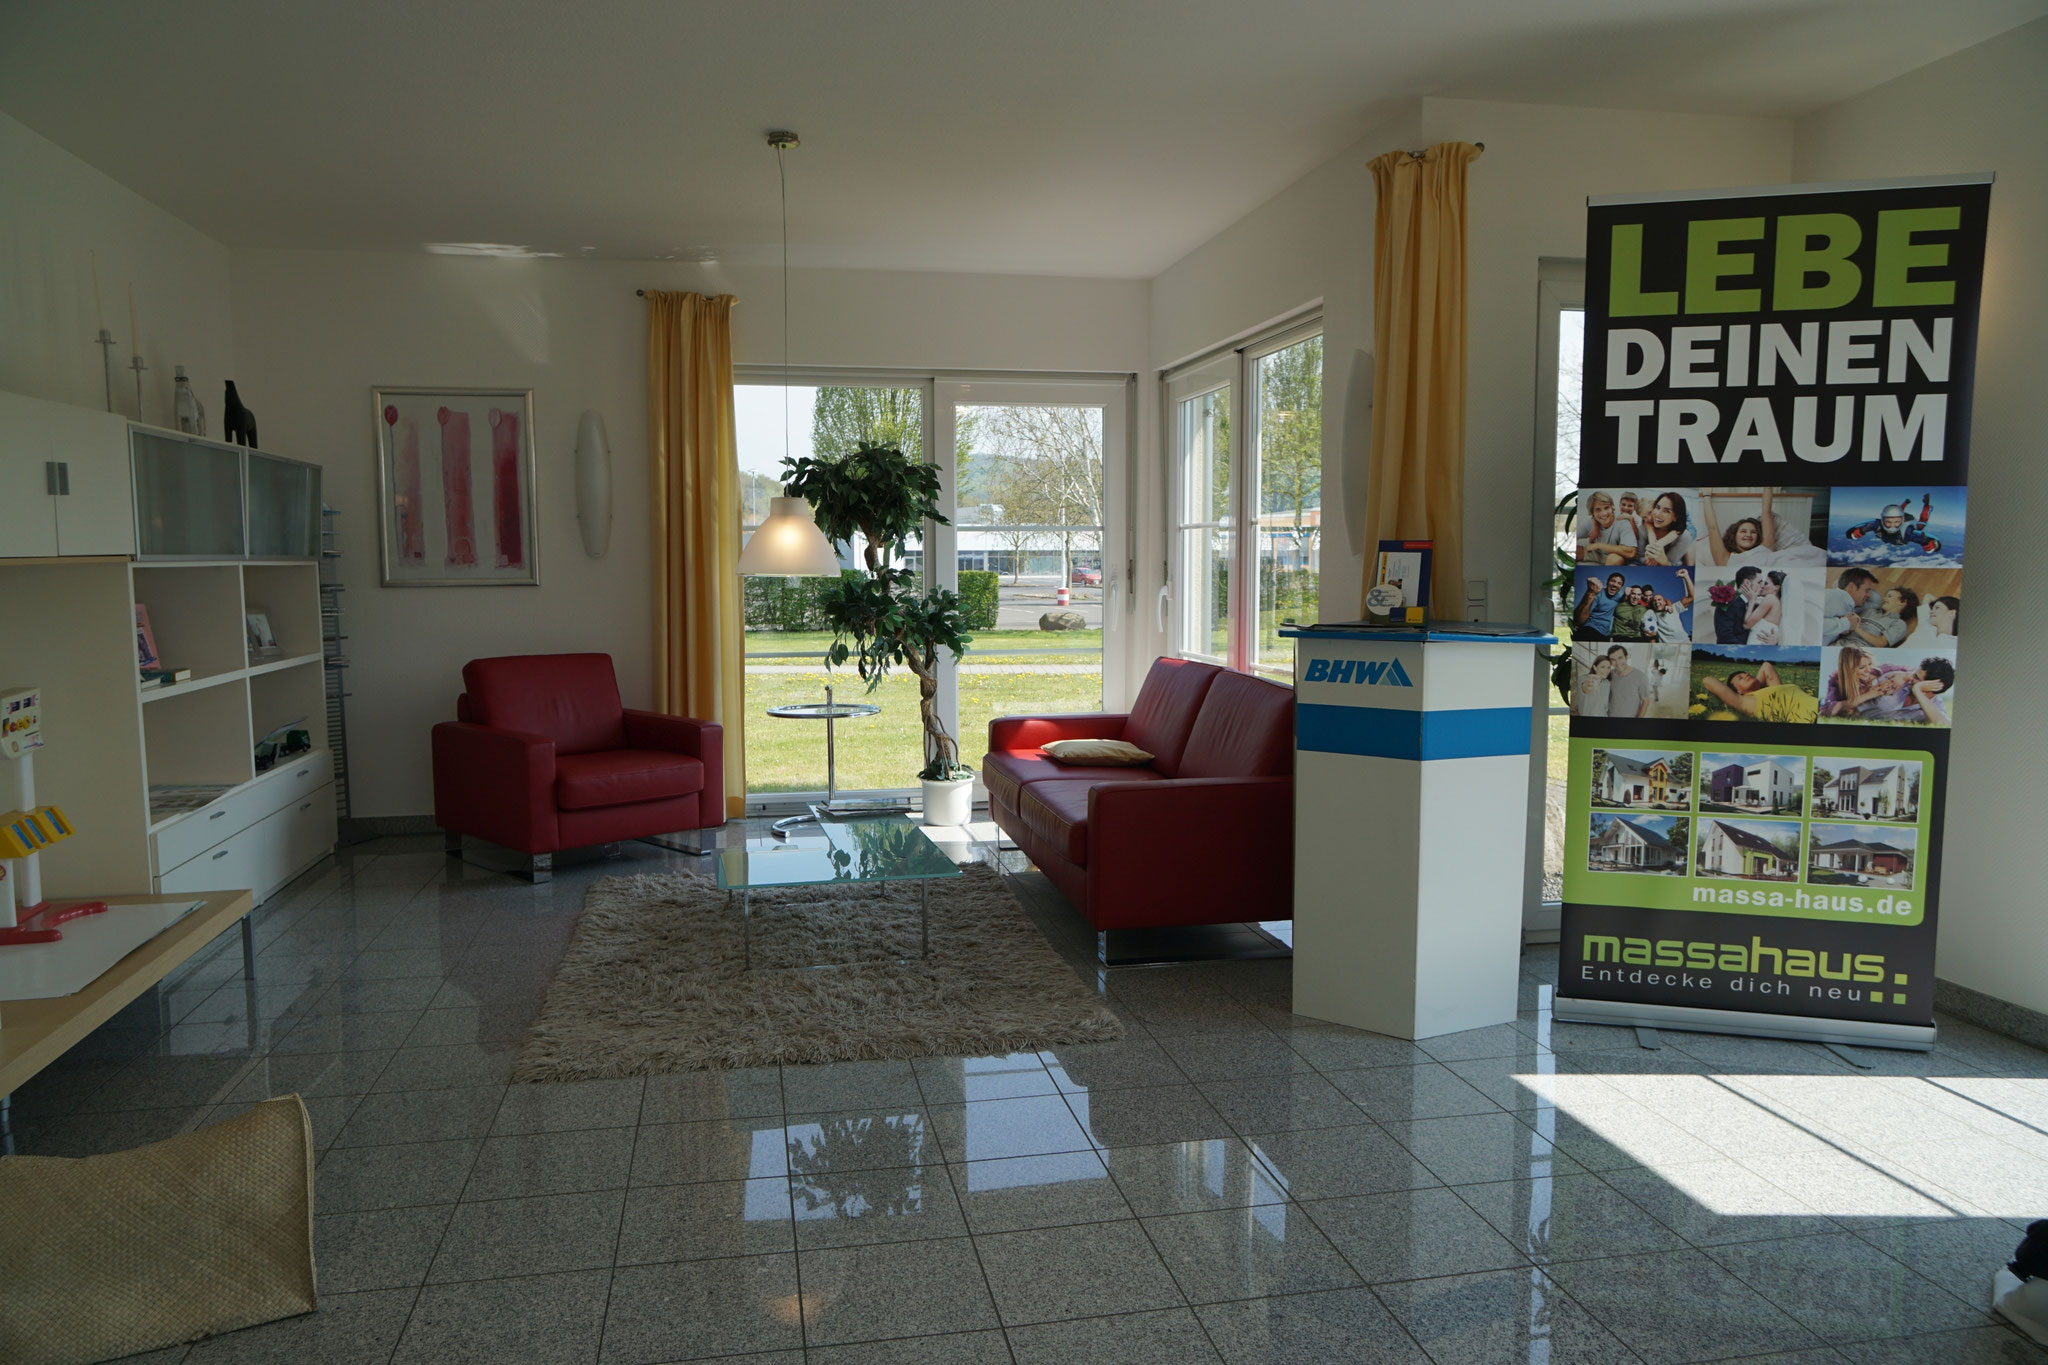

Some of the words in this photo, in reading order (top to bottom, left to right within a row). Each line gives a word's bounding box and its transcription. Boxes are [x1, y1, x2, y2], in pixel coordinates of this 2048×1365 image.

[1608, 206, 1962, 317] LEBE
[1605, 317, 1954, 390] DEINEN
[1605, 393, 1948, 464] TRAUM
[1692, 885, 1912, 916] massa-haus.de
[1581, 965, 1713, 989] Entdecke
[1730, 977, 1791, 996] dich
[1809, 985, 1861, 1001] neu
